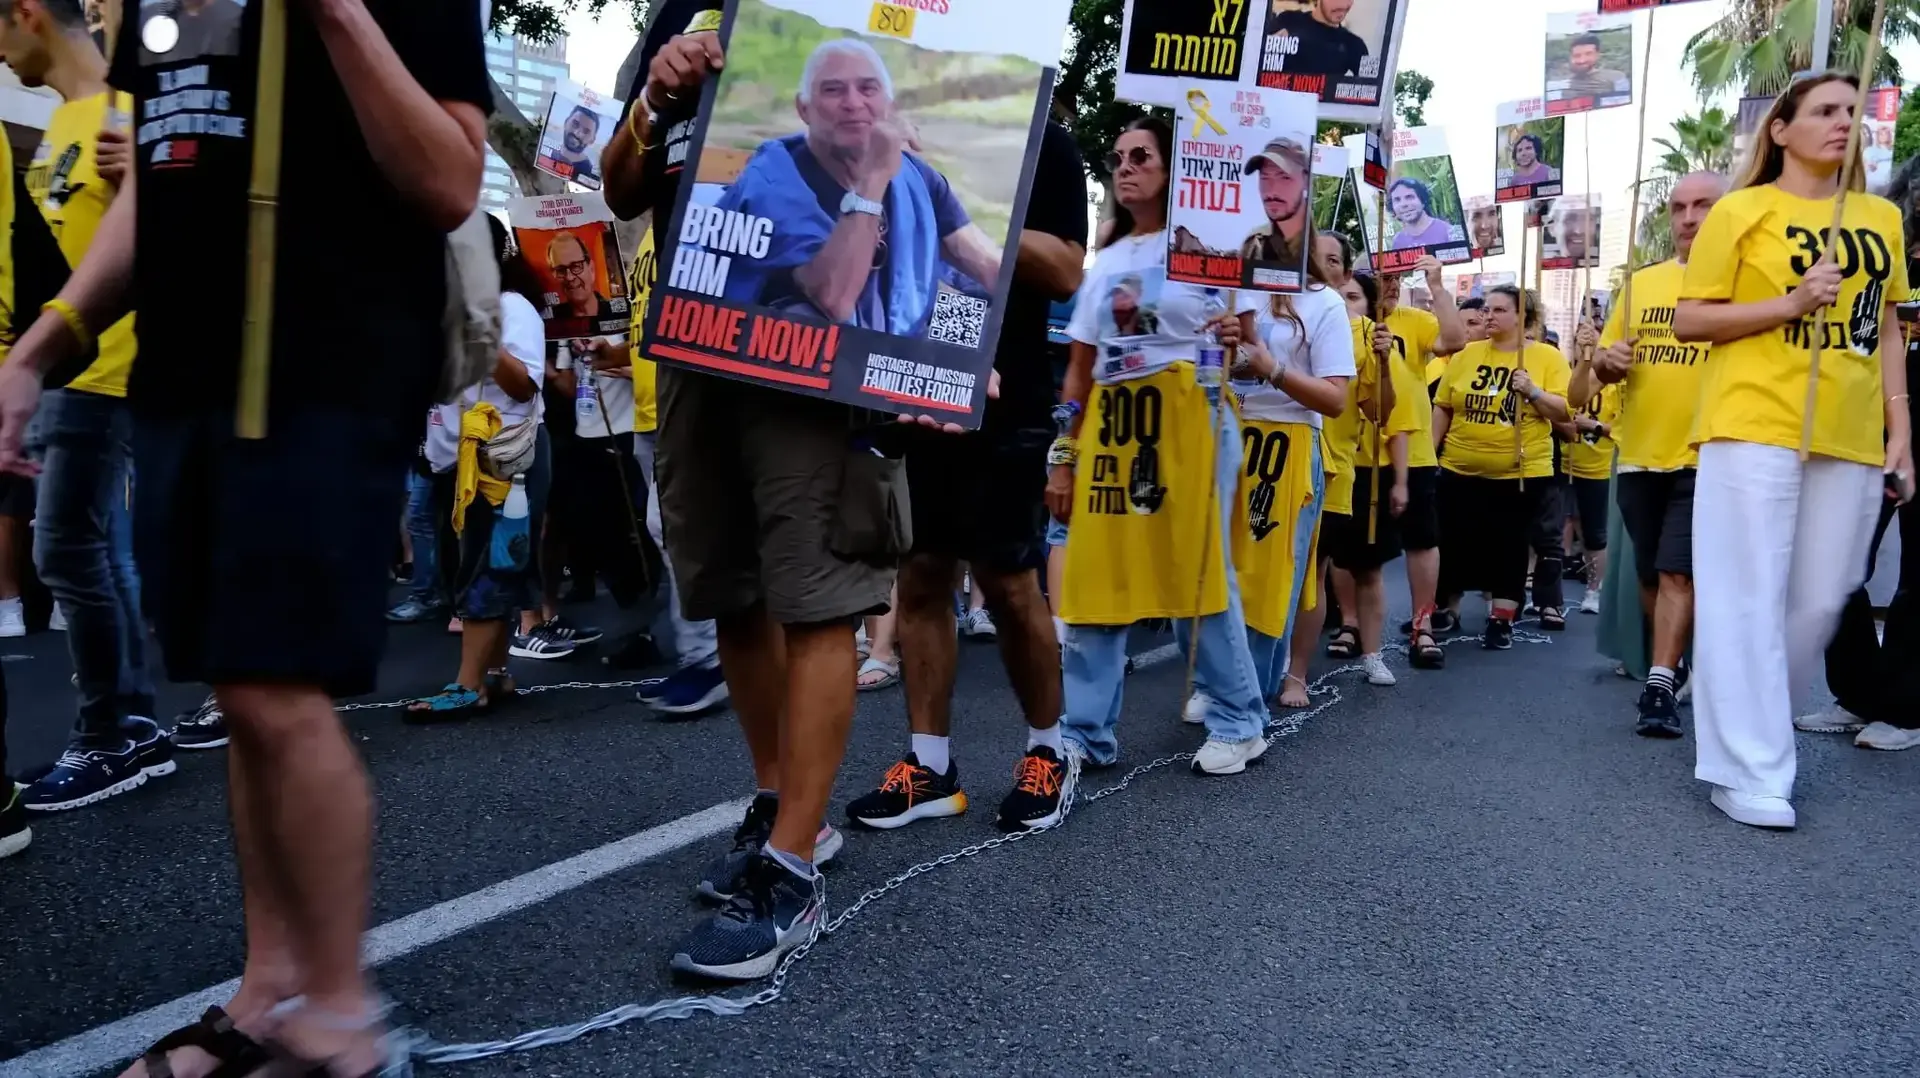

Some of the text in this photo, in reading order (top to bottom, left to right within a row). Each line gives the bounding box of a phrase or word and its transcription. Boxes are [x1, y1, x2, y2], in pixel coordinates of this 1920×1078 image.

[878, 5, 906, 32] 80
[1210, 0, 1241, 34] לא
[1150, 32, 1237, 75] מוותרת
[1265, 35, 1299, 55] BRING
[1262, 53, 1285, 72] HIM
[1260, 72, 1291, 89] HOME
[1293, 73, 1326, 94] NOW!
[1182, 140, 1244, 160] לא שוכחים
[1181, 157, 1242, 182] את איתי
[1178, 177, 1241, 214] בעזה
[679, 202, 773, 259] BRING
[1365, 223, 1394, 240] BRNG
[1170, 252, 1204, 275] HOME
[1205, 255, 1243, 278] NOW!
[1371, 251, 1399, 270] HME
[1786, 225, 1891, 281] 300
[668, 246, 731, 298] HIM
[656, 295, 747, 353] HOME
[747, 315, 840, 373] NOW!
[863, 367, 973, 407] FAMILIES FORUM
[867, 353, 975, 387] HOSTAGES AND MISSING
[1098, 385, 1163, 447] 300
[1243, 426, 1290, 483] 00
